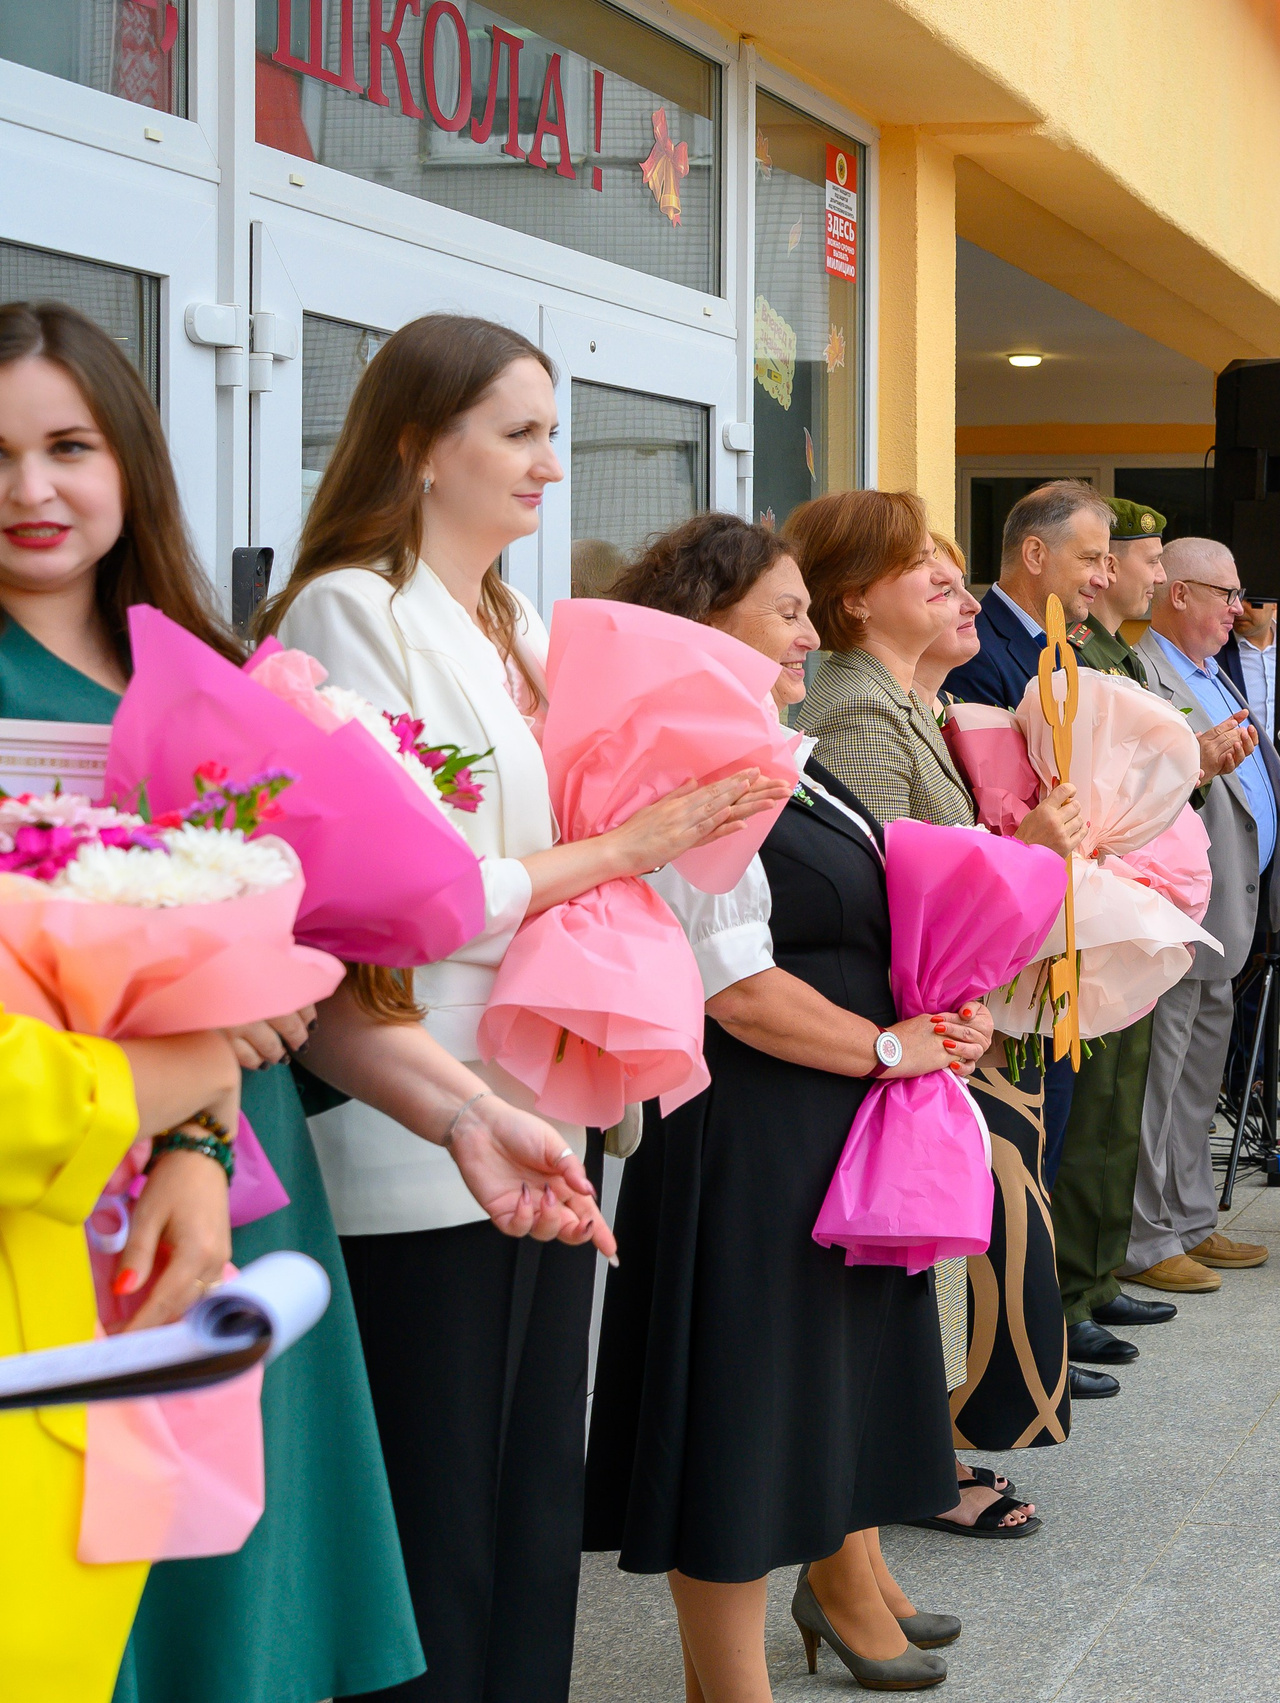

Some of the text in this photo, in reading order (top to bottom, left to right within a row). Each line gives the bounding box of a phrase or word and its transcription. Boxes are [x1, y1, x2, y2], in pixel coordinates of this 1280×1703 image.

[271, 0, 605, 193] ШКОЛА!
[827, 213, 855, 242] ЗДЕСЬ
[827, 256, 855, 277] МИЛИЦИЮ
